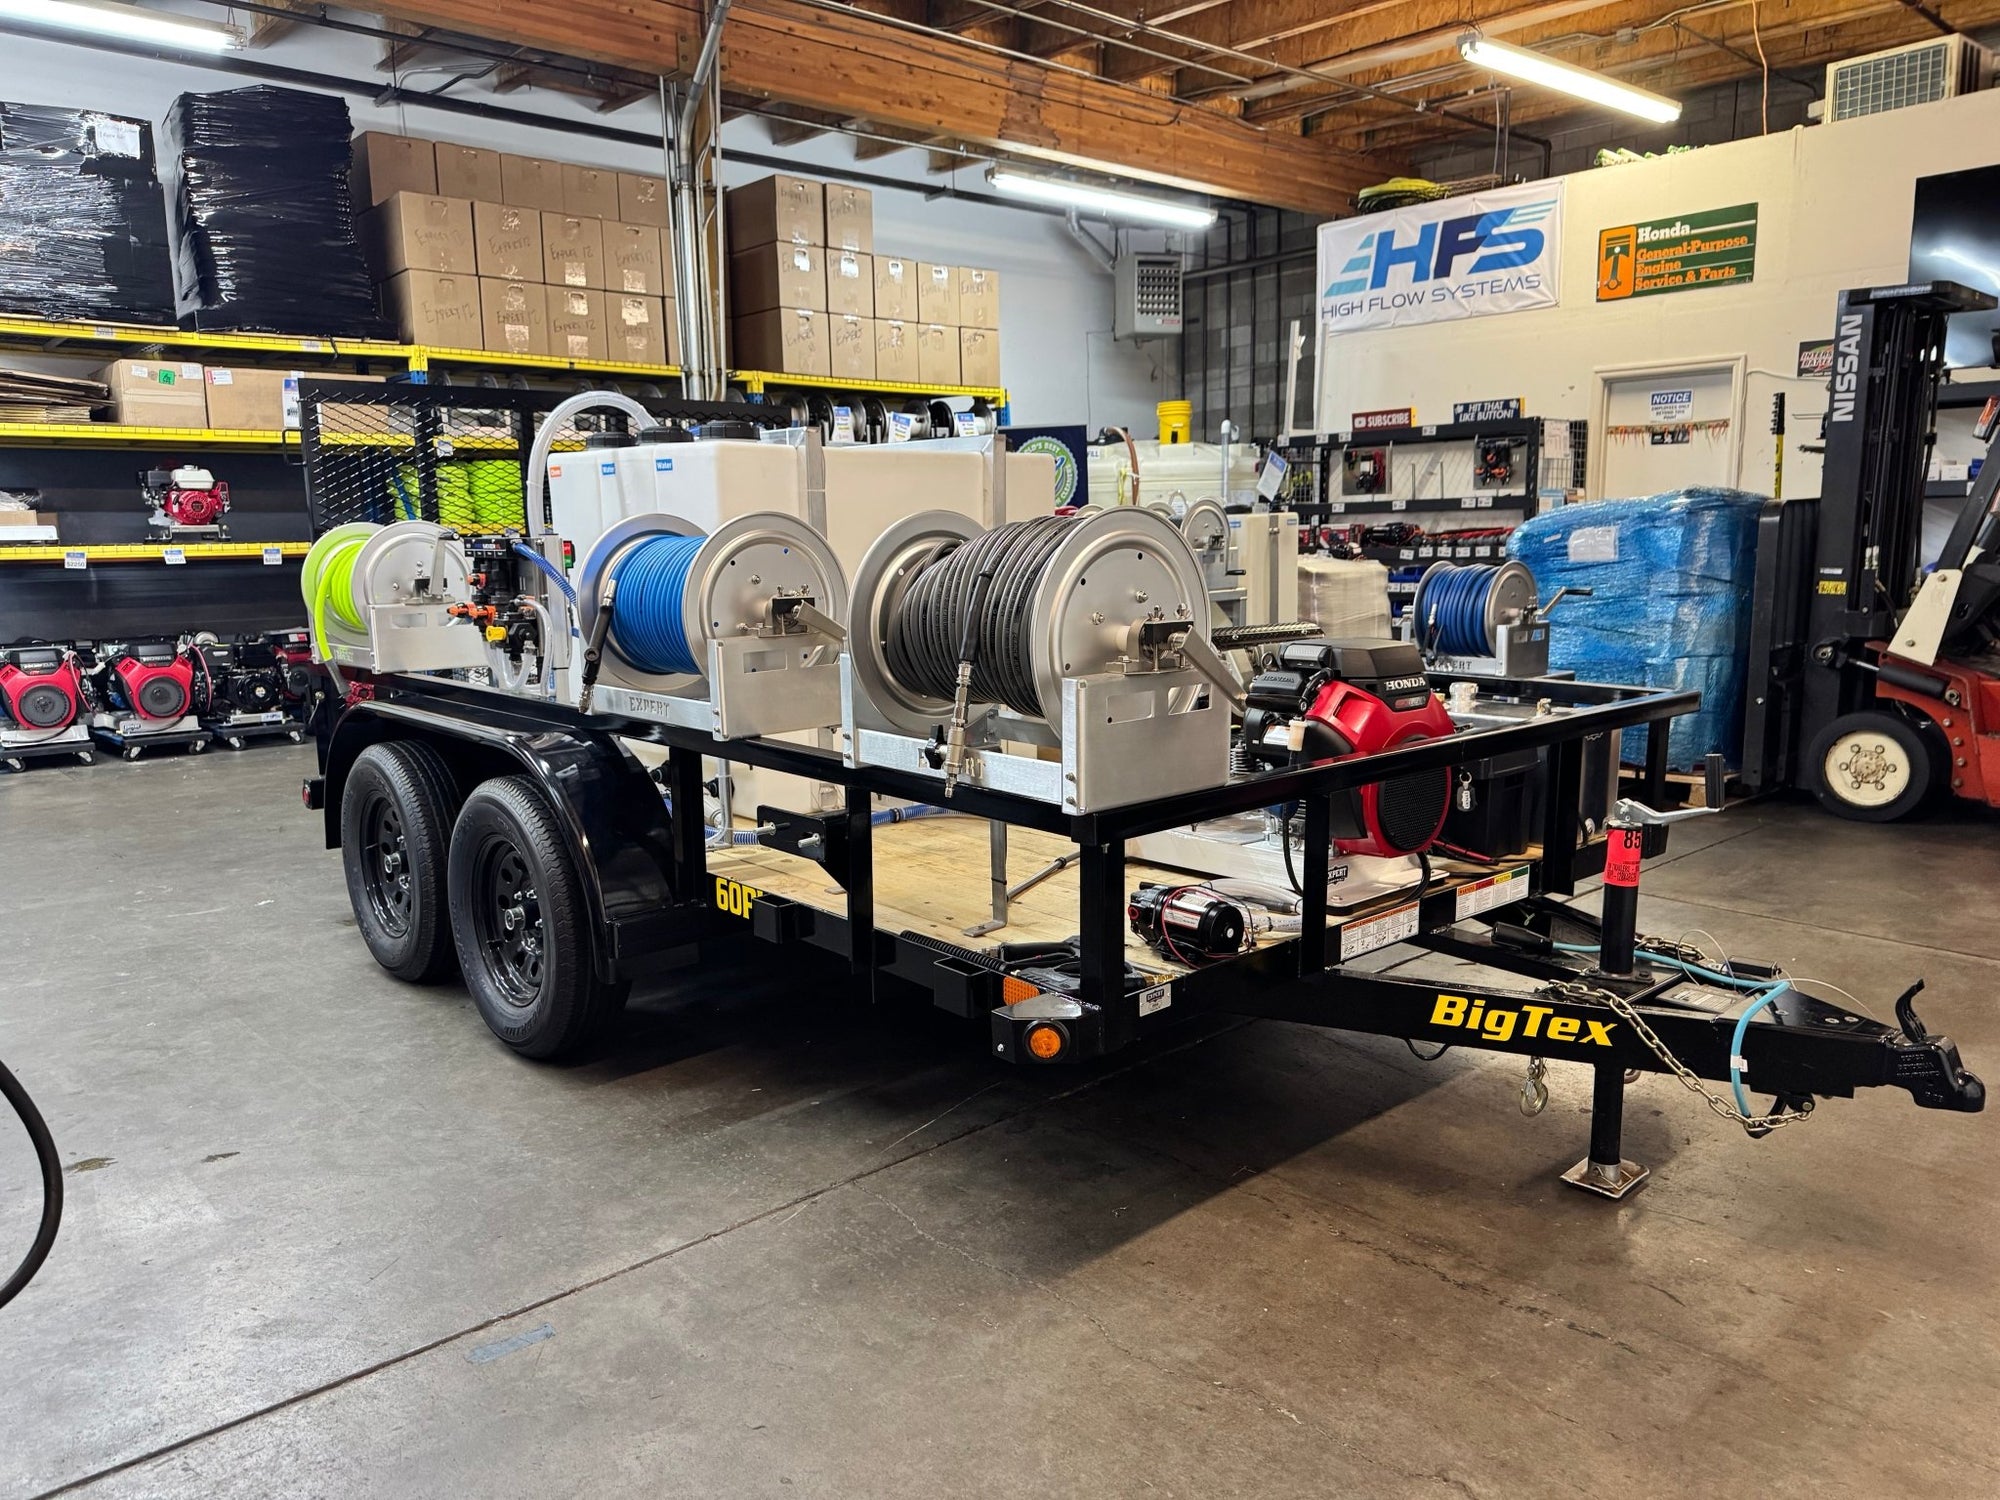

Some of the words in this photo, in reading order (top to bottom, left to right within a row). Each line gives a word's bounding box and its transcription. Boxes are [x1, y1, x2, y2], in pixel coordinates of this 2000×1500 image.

[1637, 221, 1690, 244] Honda
[1635, 260, 1681, 276] Engine
[1635, 274, 1683, 290] Service
[1686, 270, 1696, 283] &
[1699, 266, 1736, 281] Parts
[1321, 303, 1364, 320] HIGH
[1368, 291, 1426, 313] FLOW
[1431, 273, 1542, 303] SYSTEMS
[1832, 313, 1863, 422] NISSAN
[1652, 392, 1690, 404] NOTICE
[1468, 404, 1482, 412] HIT
[1484, 401, 1504, 411] THAT
[1367, 412, 1410, 428] SUBSCRIBE
[1459, 412, 1475, 423] LIKE
[1477, 410, 1513, 420] BUTTON!
[656, 461, 672, 470] Water
[1385, 676, 1426, 691] HONDA
[629, 696, 670, 717] EXPERT
[1327, 867, 1347, 880] XPERT
[716, 877, 763, 920] 60P
[1429, 994, 1618, 1047] BigTex
